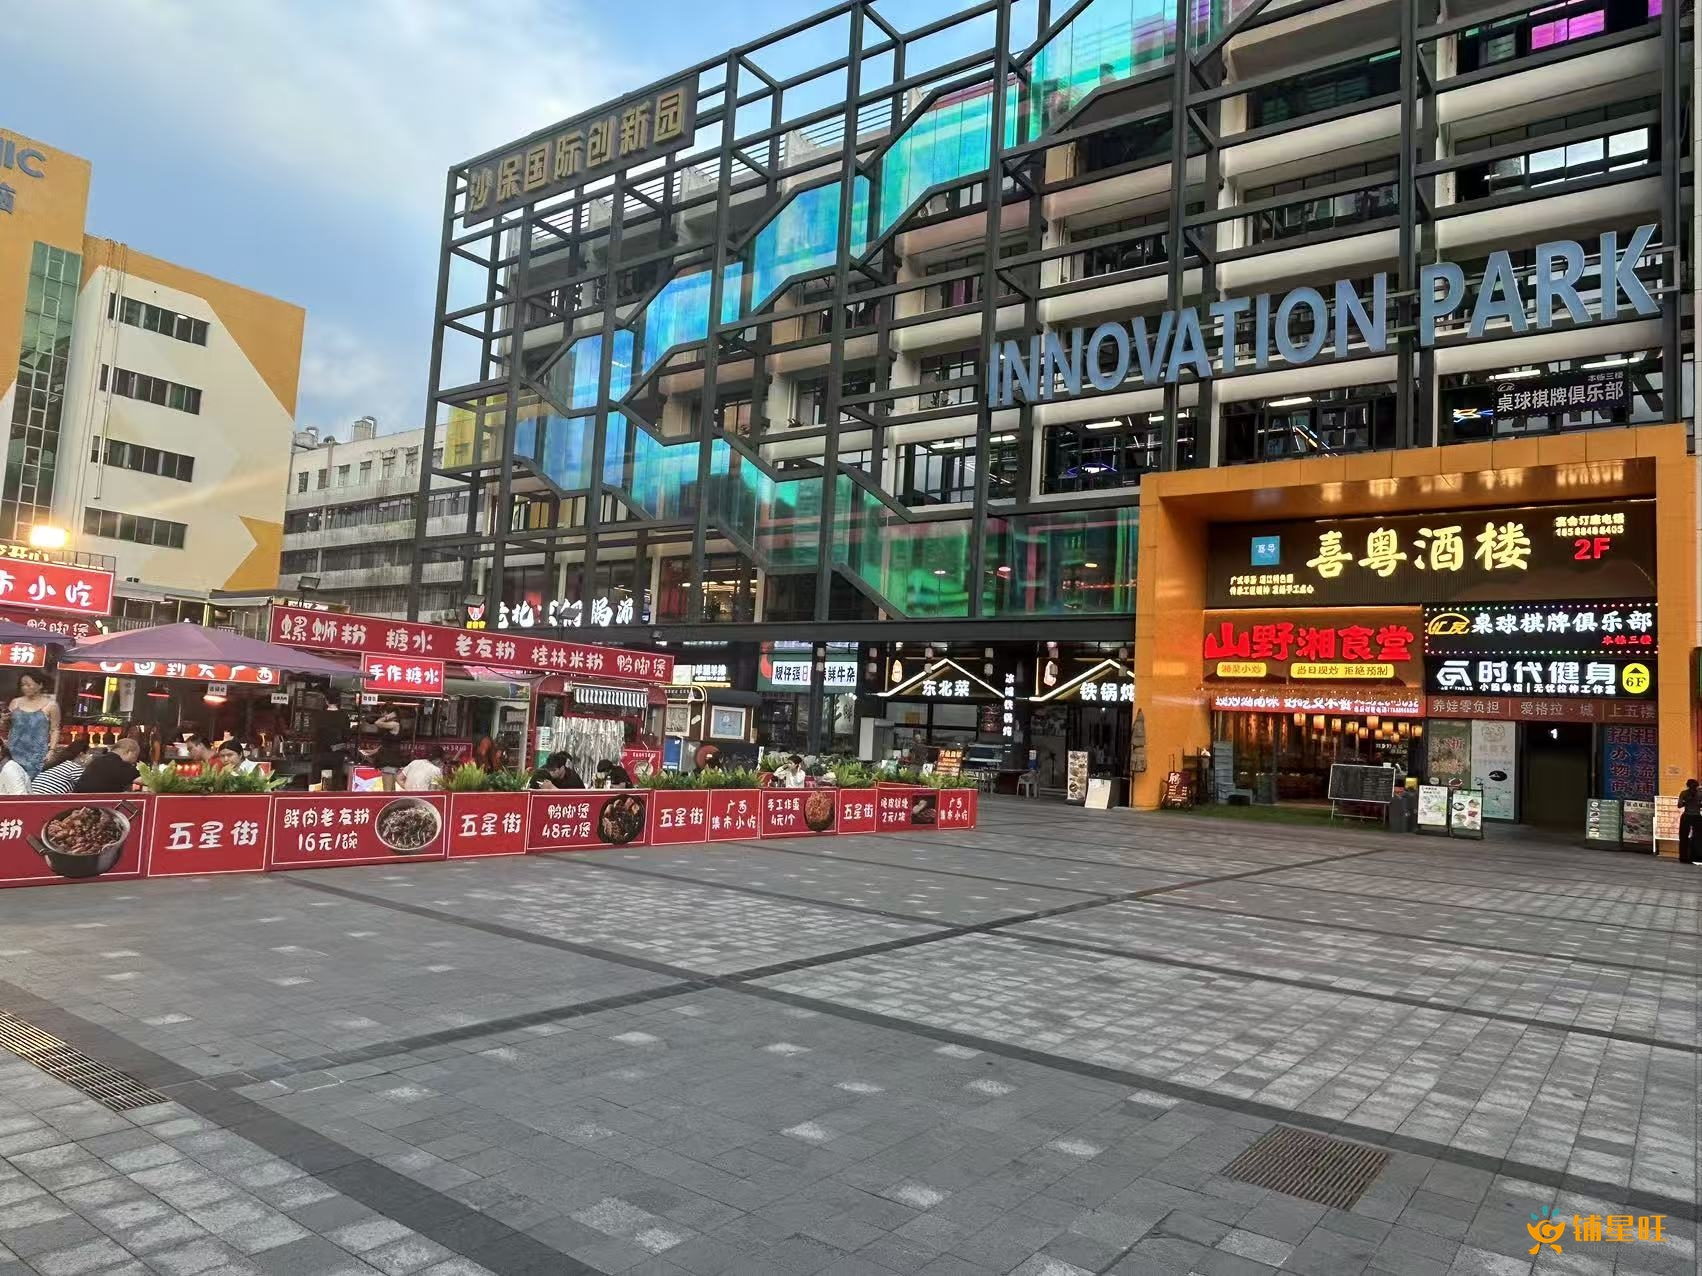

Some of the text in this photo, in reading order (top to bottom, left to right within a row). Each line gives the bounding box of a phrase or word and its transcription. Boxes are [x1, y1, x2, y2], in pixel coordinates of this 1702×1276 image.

[0, 137, 46, 178] IC
[987, 224, 1661, 407] INNOVATION PARK
[1496, 381, 1625, 412] 桌球棋牌俱乐部
[1306, 520, 1533, 579] 喜粤酒楼
[1574, 537, 1611, 560] 2F
[1472, 610, 1653, 635] 桌球棋牌俱乐部
[279, 614, 368, 646] 螺蛳粉
[385, 627, 433, 653] 糖水
[456, 634, 516, 660] 老友粉
[531, 645, 604, 671] 桂林米粉
[1204, 622, 1415, 661] 山野湘食堂
[369, 663, 440, 685] 手作糖水
[1478, 660, 1617, 685] 时代健身
[1626, 676, 1647, 688] 6F
[922, 679, 971, 697] 东北菜
[284, 806, 371, 830] 鲜肉老友粉
[659, 807, 704, 828] 五星街
[726, 799, 747, 815] 广西
[843, 803, 874, 820] 五星街
[458, 813, 522, 837] 五星街
[541, 821, 592, 839] 48元/煲
[711, 815, 757, 830] 集市小吃
[165, 820, 259, 850] 五星街
[298, 831, 359, 852] 16元/碗
